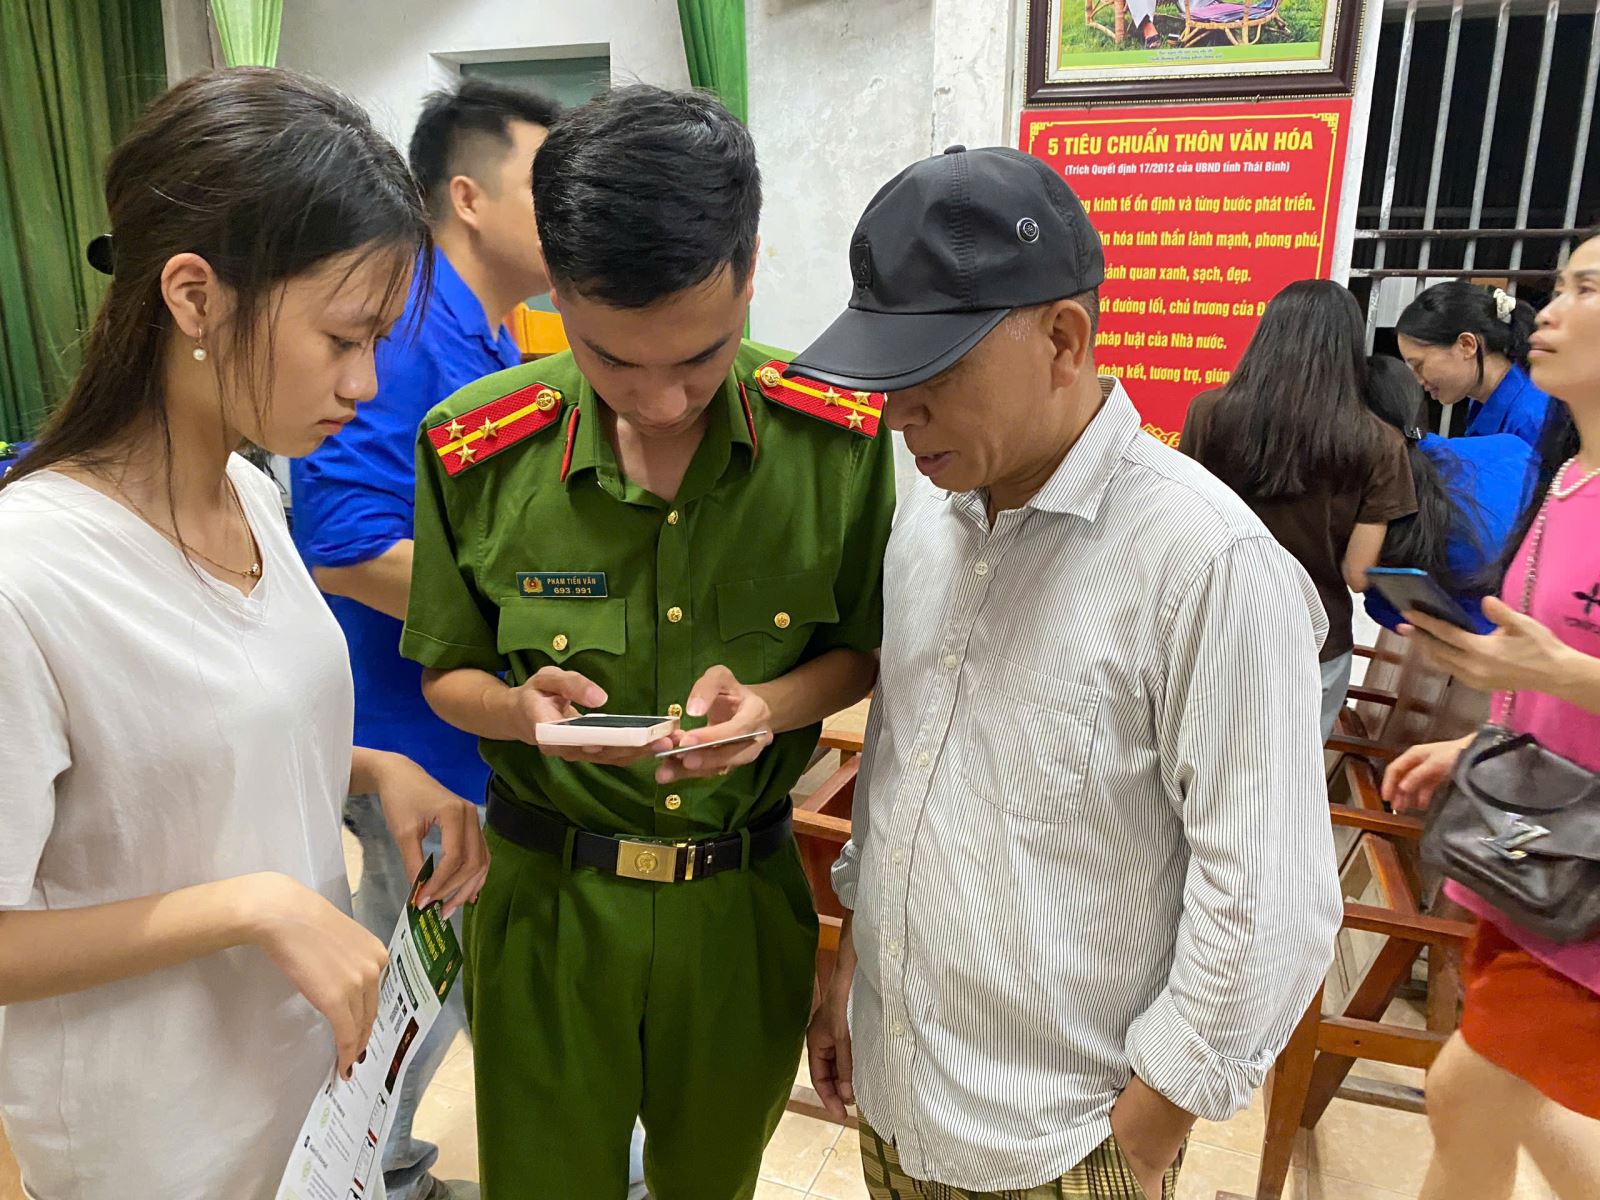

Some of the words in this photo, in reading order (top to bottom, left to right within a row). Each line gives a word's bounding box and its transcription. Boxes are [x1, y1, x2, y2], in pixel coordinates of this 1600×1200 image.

[1048, 138, 1058, 155] 5
[1064, 133, 1102, 155] TIÊU
[1107, 128, 1169, 154] CHUẨN
[1175, 130, 1224, 152] THÔN
[1230, 129, 1268, 151] VĂN
[1274, 128, 1313, 150] HÓA
[1065, 164, 1089, 175] (Trích
[1092, 162, 1116, 175] Quyết
[1118, 163, 1136, 175] định
[1140, 163, 1174, 173] 17/2012
[1176, 161, 1193, 172] của
[1195, 162, 1220, 172] UBND
[1243, 161, 1263, 172] Thái
[1265, 161, 1290, 172] Bình)
[1094, 197, 1117, 212] kinh
[1121, 194, 1132, 212] tế
[1134, 193, 1148, 212] ổn
[1151, 196, 1176, 214] định
[1179, 195, 1192, 211] và
[1195, 195, 1220, 213] từng
[1223, 196, 1252, 212] bước
[1255, 196, 1282, 213] phát
[1284, 192, 1316, 211] triển.
[1113, 231, 1133, 246] hóa
[1136, 231, 1157, 246] tinh
[1161, 228, 1185, 246] thần
[1188, 231, 1213, 246] lành
[1216, 231, 1251, 249] mạnh,
[1255, 232, 1291, 248] phong
[1295, 231, 1320, 248] phú.
[1129, 267, 1156, 281] quan
[1159, 266, 1189, 282] xanh,
[1193, 266, 1223, 283] sạch,
[1227, 267, 1251, 284] đẹp.
[1100, 296, 1110, 312] ốt
[1112, 296, 1146, 315] đường
[1148, 297, 1166, 315] lối,
[1169, 298, 1190, 314] chủ
[1193, 300, 1229, 317] trương
[1232, 299, 1254, 316] của
[1095, 331, 1121, 347] pháp
[1124, 331, 1145, 349] luật
[1147, 331, 1168, 347] của
[1171, 333, 1193, 348] Nhà
[1196, 333, 1227, 349] nước.
[1126, 363, 1146, 380] kết,
[1150, 366, 1180, 381] tương
[1205, 367, 1230, 384] giúp
